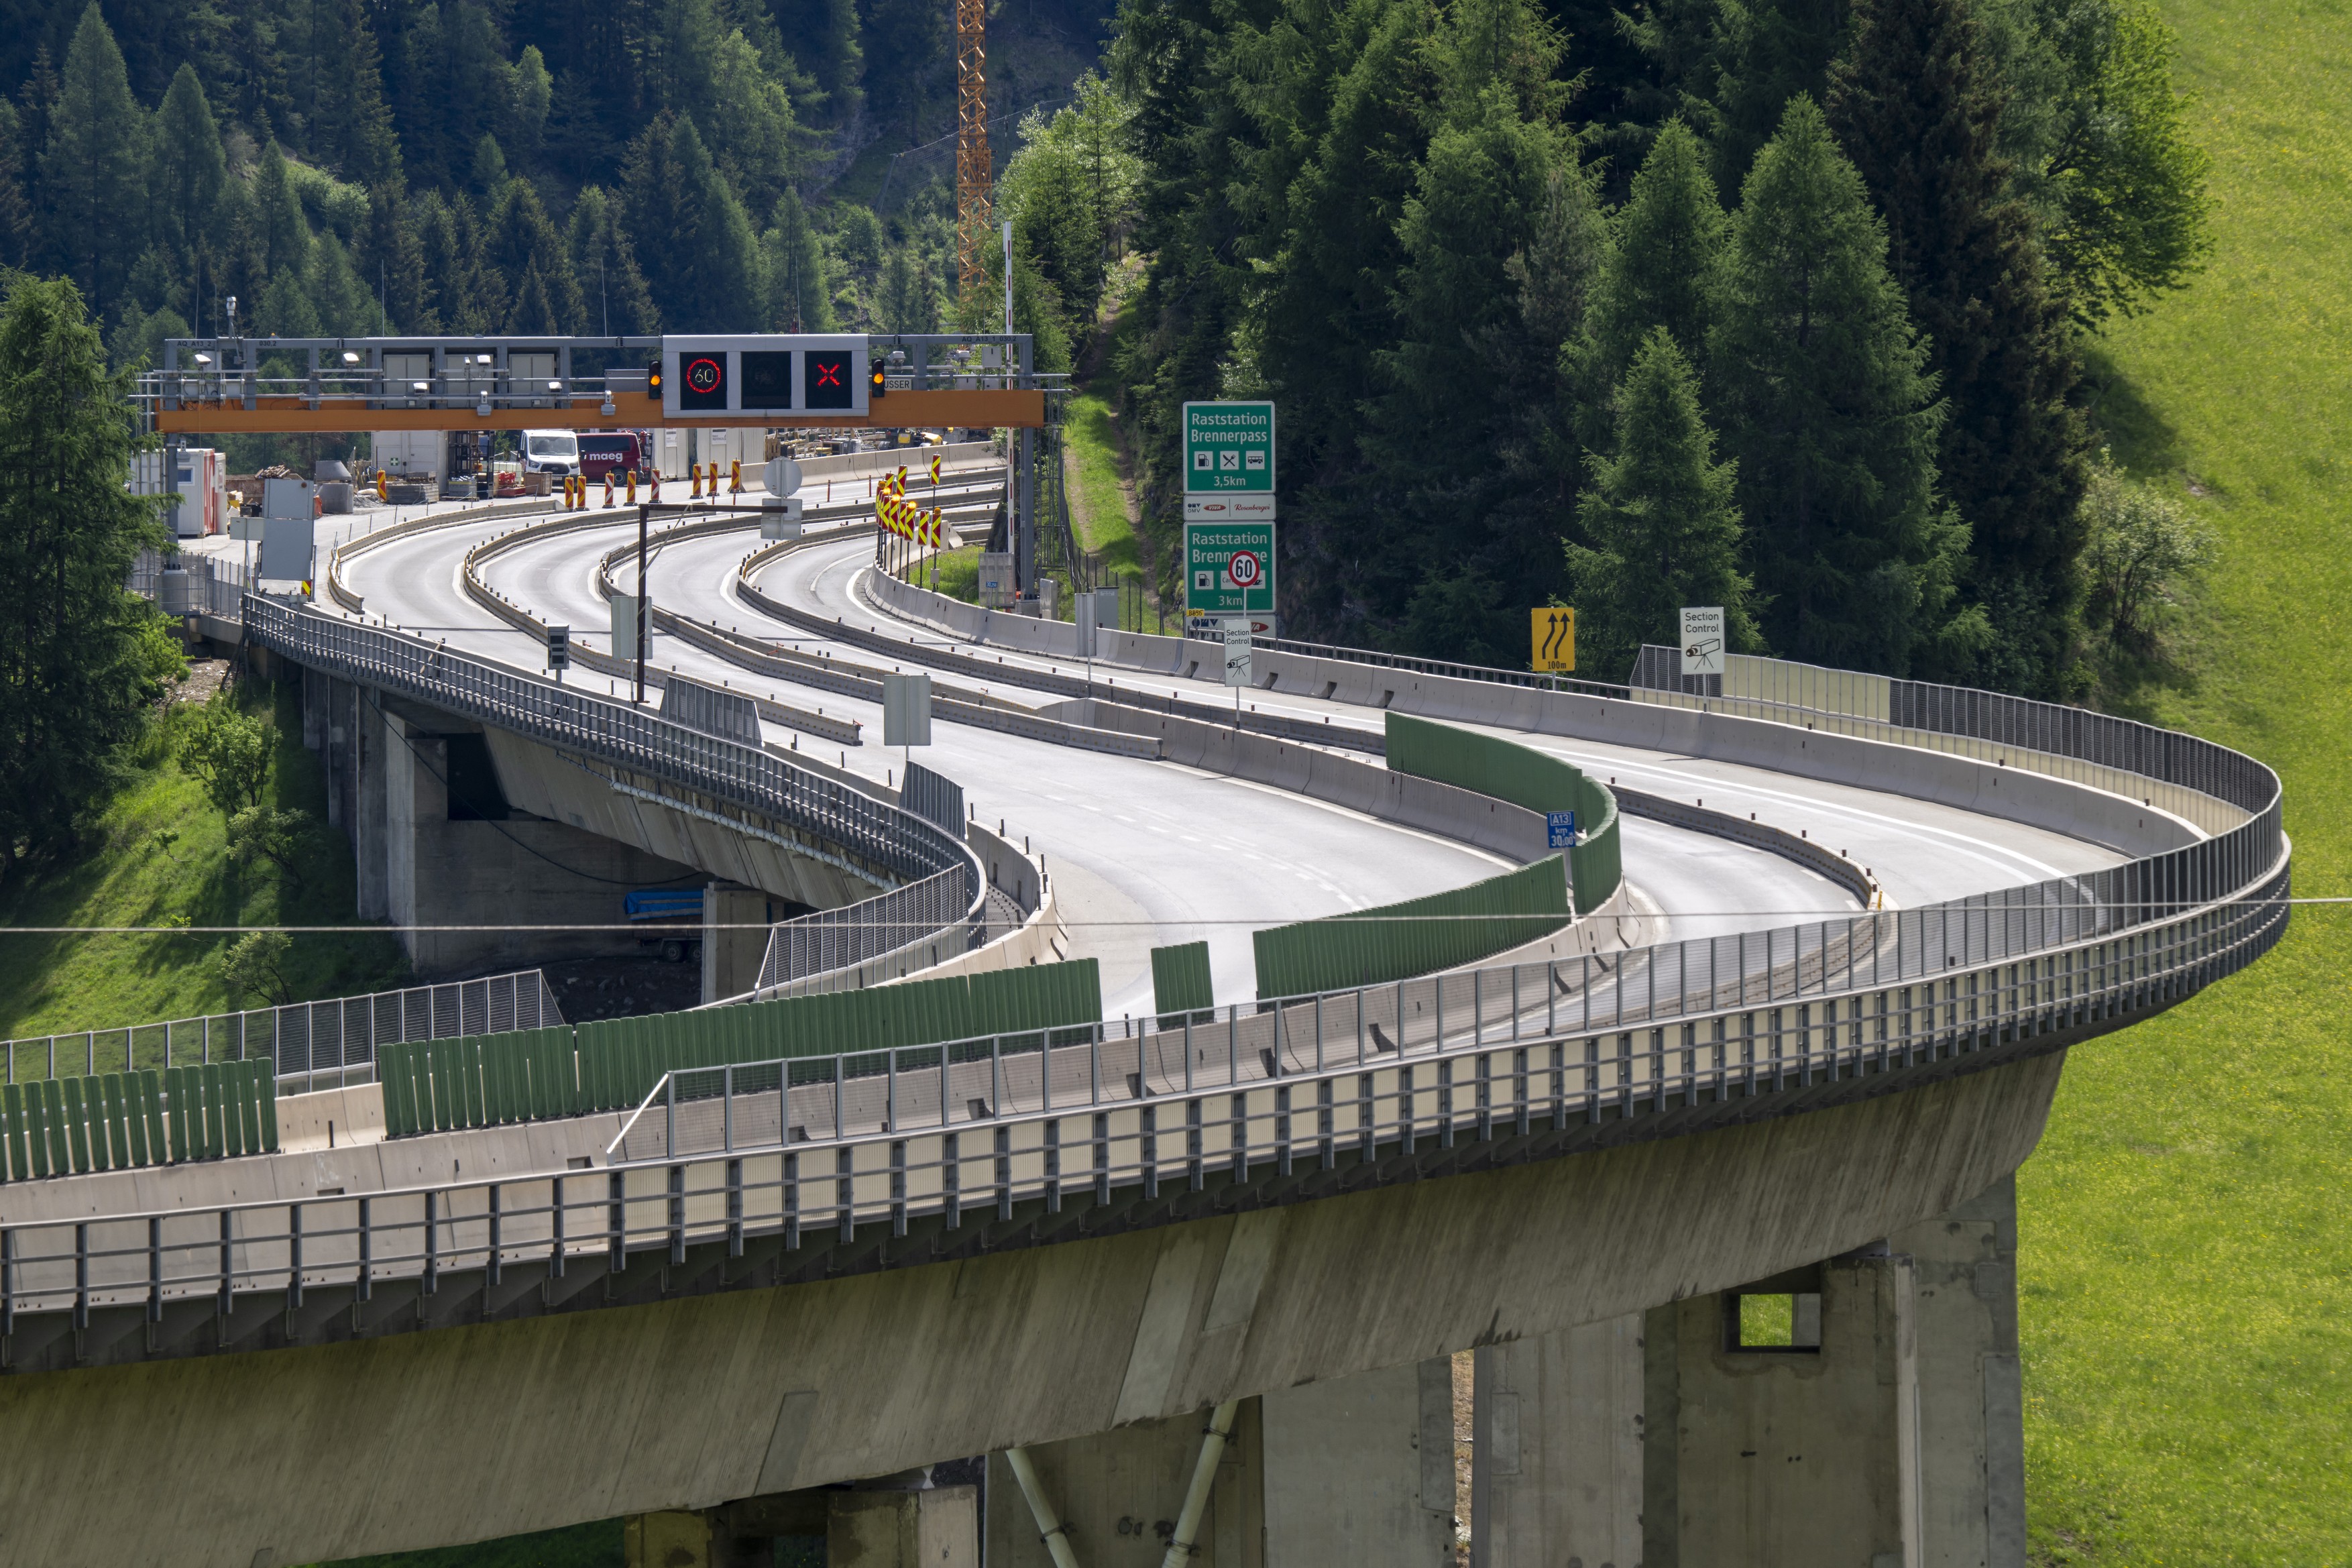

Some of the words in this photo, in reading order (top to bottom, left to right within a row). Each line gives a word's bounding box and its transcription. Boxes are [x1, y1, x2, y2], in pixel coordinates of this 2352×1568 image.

[695, 369, 714, 383] 60
[885, 380, 909, 389] USSER
[1192, 412, 1266, 425] Raststation
[1191, 429, 1267, 445] Brennerpass
[590, 453, 623, 463] maeg
[1214, 475, 1246, 488] 3,5km
[1234, 504, 1270, 512] Rosenberger
[1192, 532, 1267, 545] Raststation
[1192, 549, 1268, 563] Brennee
[1235, 559, 1253, 578] 60
[1685, 612, 1719, 621] Section
[1685, 624, 1720, 633] Control
[1547, 661, 1567, 669] 100m
[1552, 814, 1569, 824] A13
